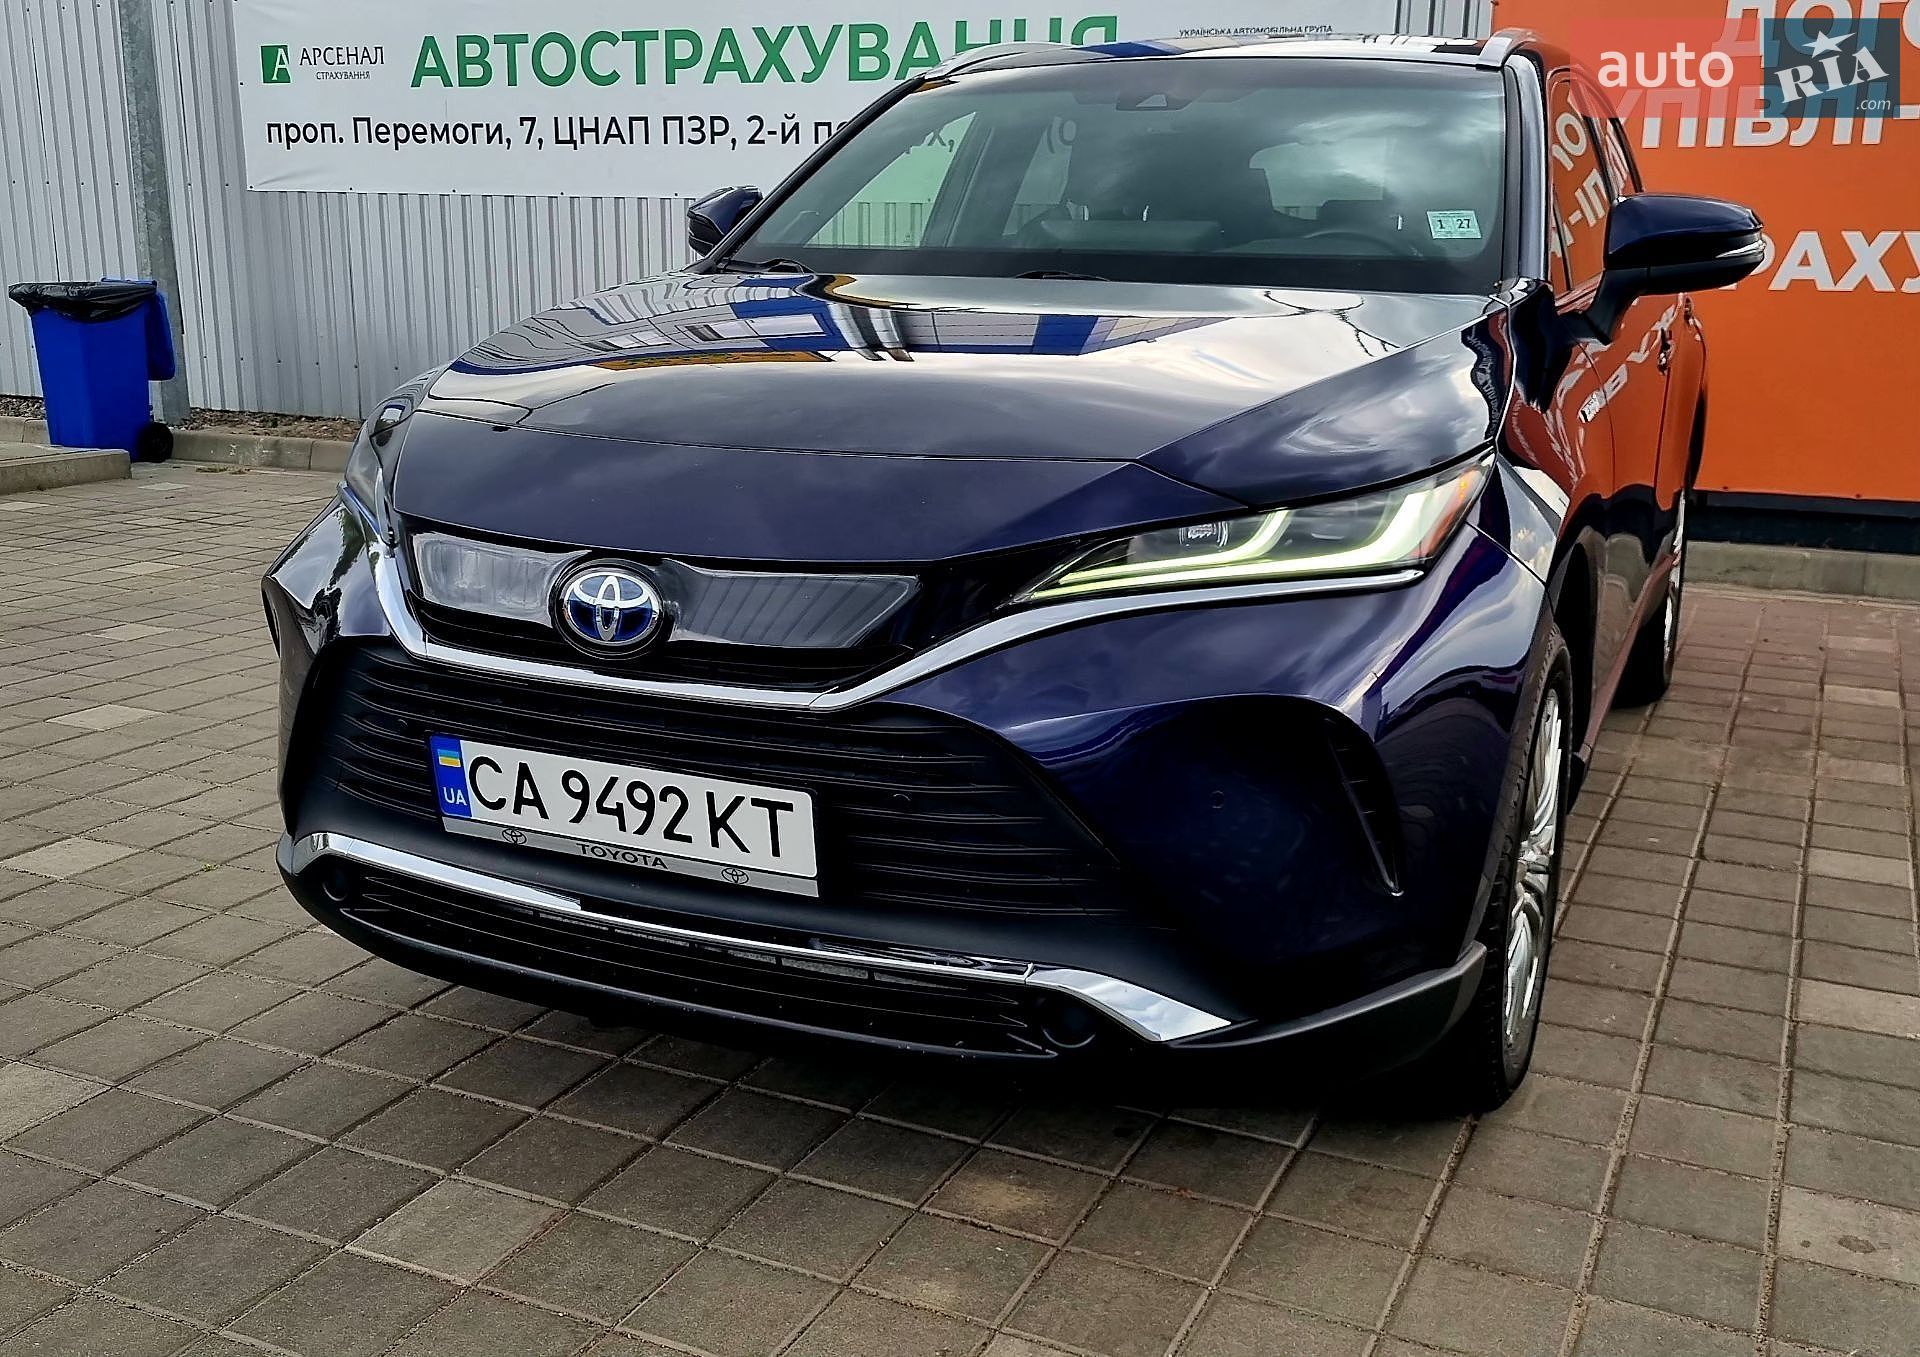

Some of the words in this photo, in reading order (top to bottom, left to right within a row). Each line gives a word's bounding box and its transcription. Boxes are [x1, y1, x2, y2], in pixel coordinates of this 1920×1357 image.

[1304, 25, 1333, 34] ГРУПА
[299, 46, 385, 66] АРСЕНАЛ
[315, 71, 370, 81] СТРАХУВАННЯ
[266, 121, 344, 150] проп.
[353, 117, 512, 151] Перемоги,
[519, 117, 544, 150] 7,
[553, 117, 651, 150] ЦНАП
[662, 116, 737, 150] ПЗР,
[746, 113, 800, 145] 2-й
[1456, 218, 1471, 229] 27
[443, 785, 468, 806] UA
[469, 755, 549, 820] CA
[561, 769, 693, 844] 9492
[705, 790, 794, 858] KT
[576, 842, 670, 871] TOYOTA
